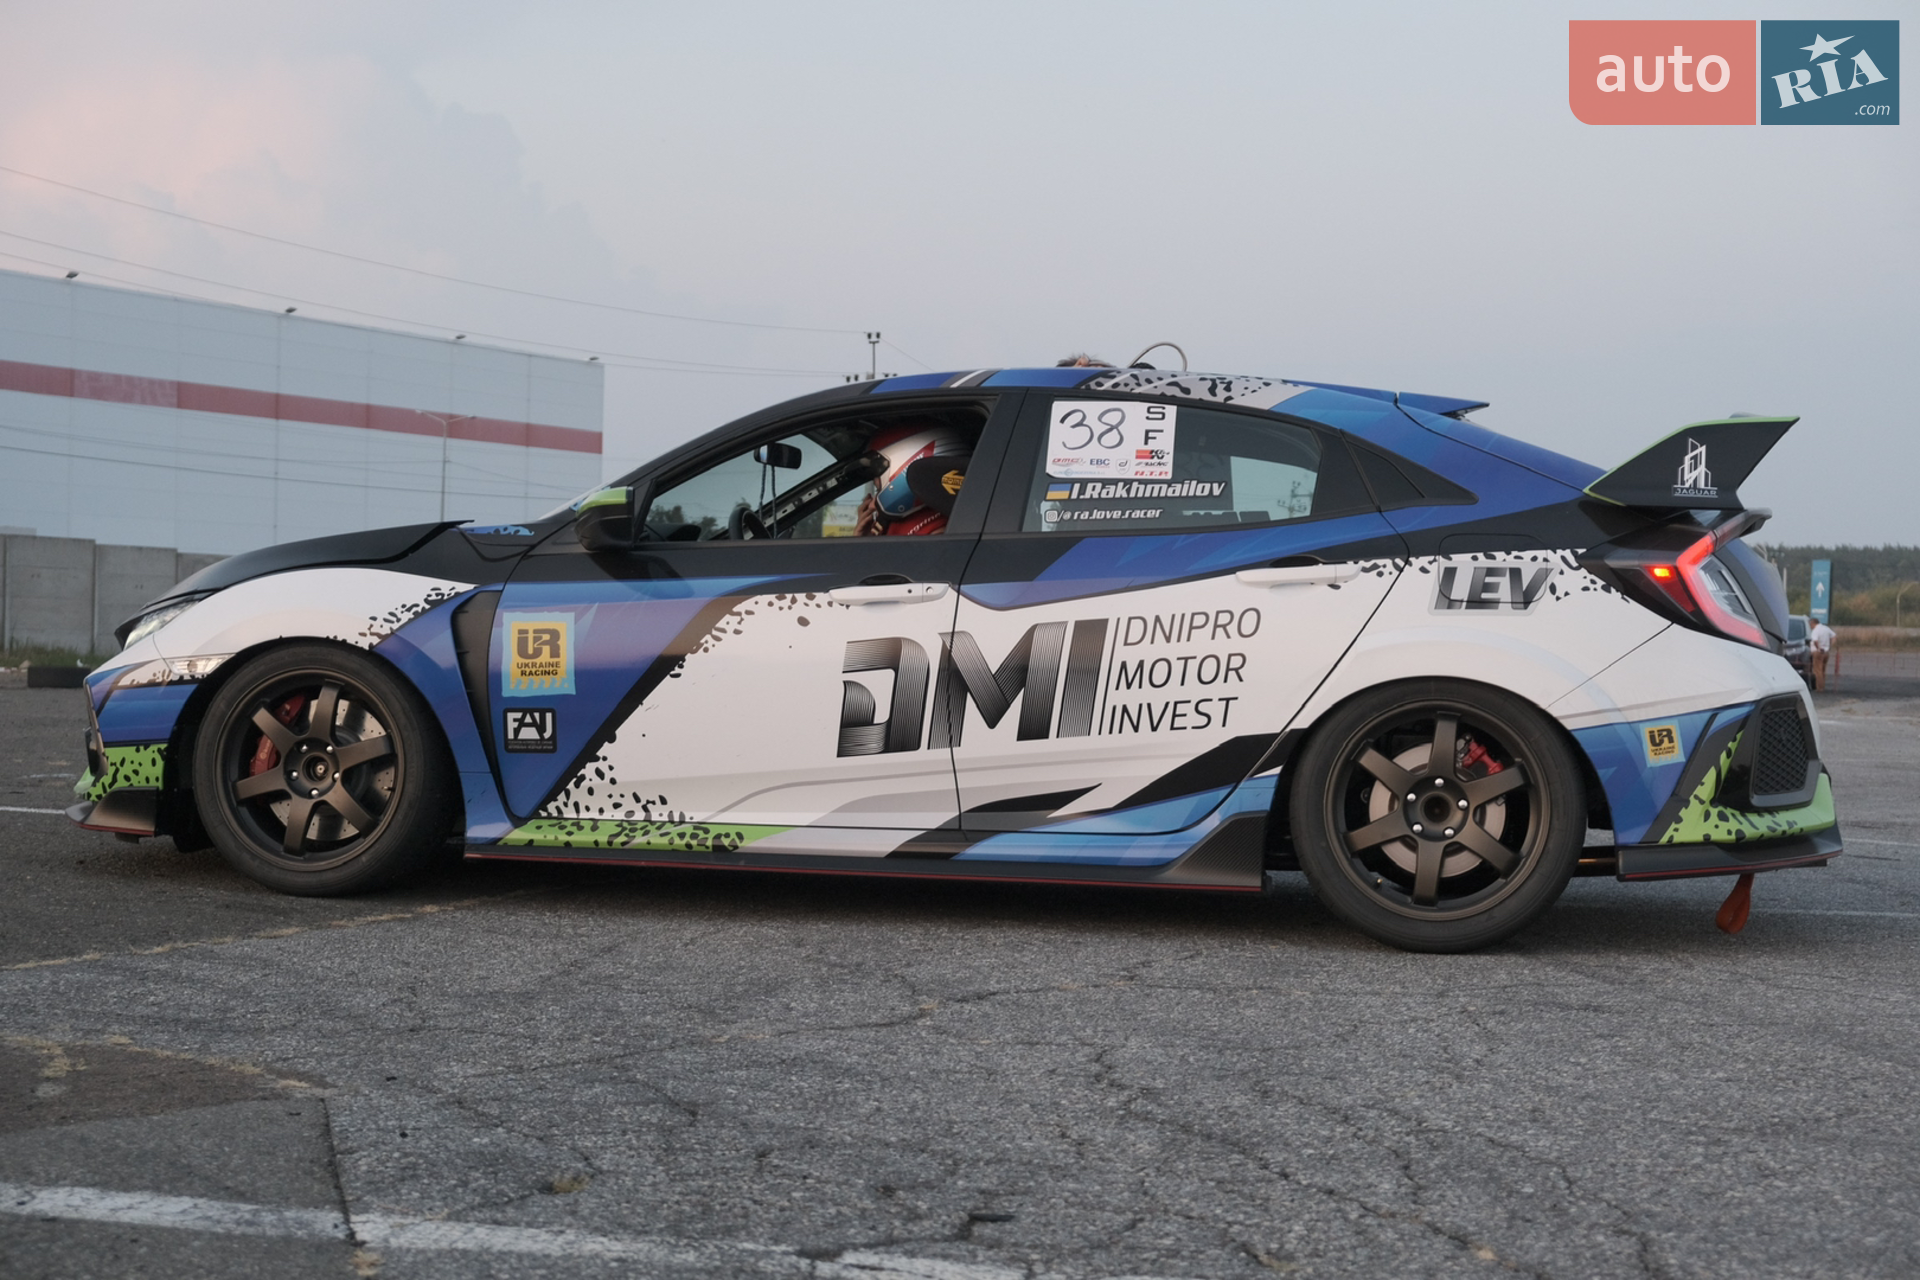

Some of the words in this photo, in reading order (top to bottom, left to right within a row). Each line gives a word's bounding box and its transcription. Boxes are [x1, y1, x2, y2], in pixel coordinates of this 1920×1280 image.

[1145, 405, 1166, 421] S
[1059, 407, 1127, 451] 38
[1143, 429, 1165, 446] F
[1089, 457, 1111, 466] EBC
[1070, 480, 1226, 500] I.Rakhmailov
[1674, 488, 1718, 496] JAGUAR
[1433, 566, 1555, 611] LEV
[1122, 607, 1262, 647] DNIPRO
[517, 661, 561, 670] UKRAINE
[520, 669, 559, 677] RACING
[1114, 652, 1248, 692] MOTOR
[1108, 696, 1239, 735] INVEST
